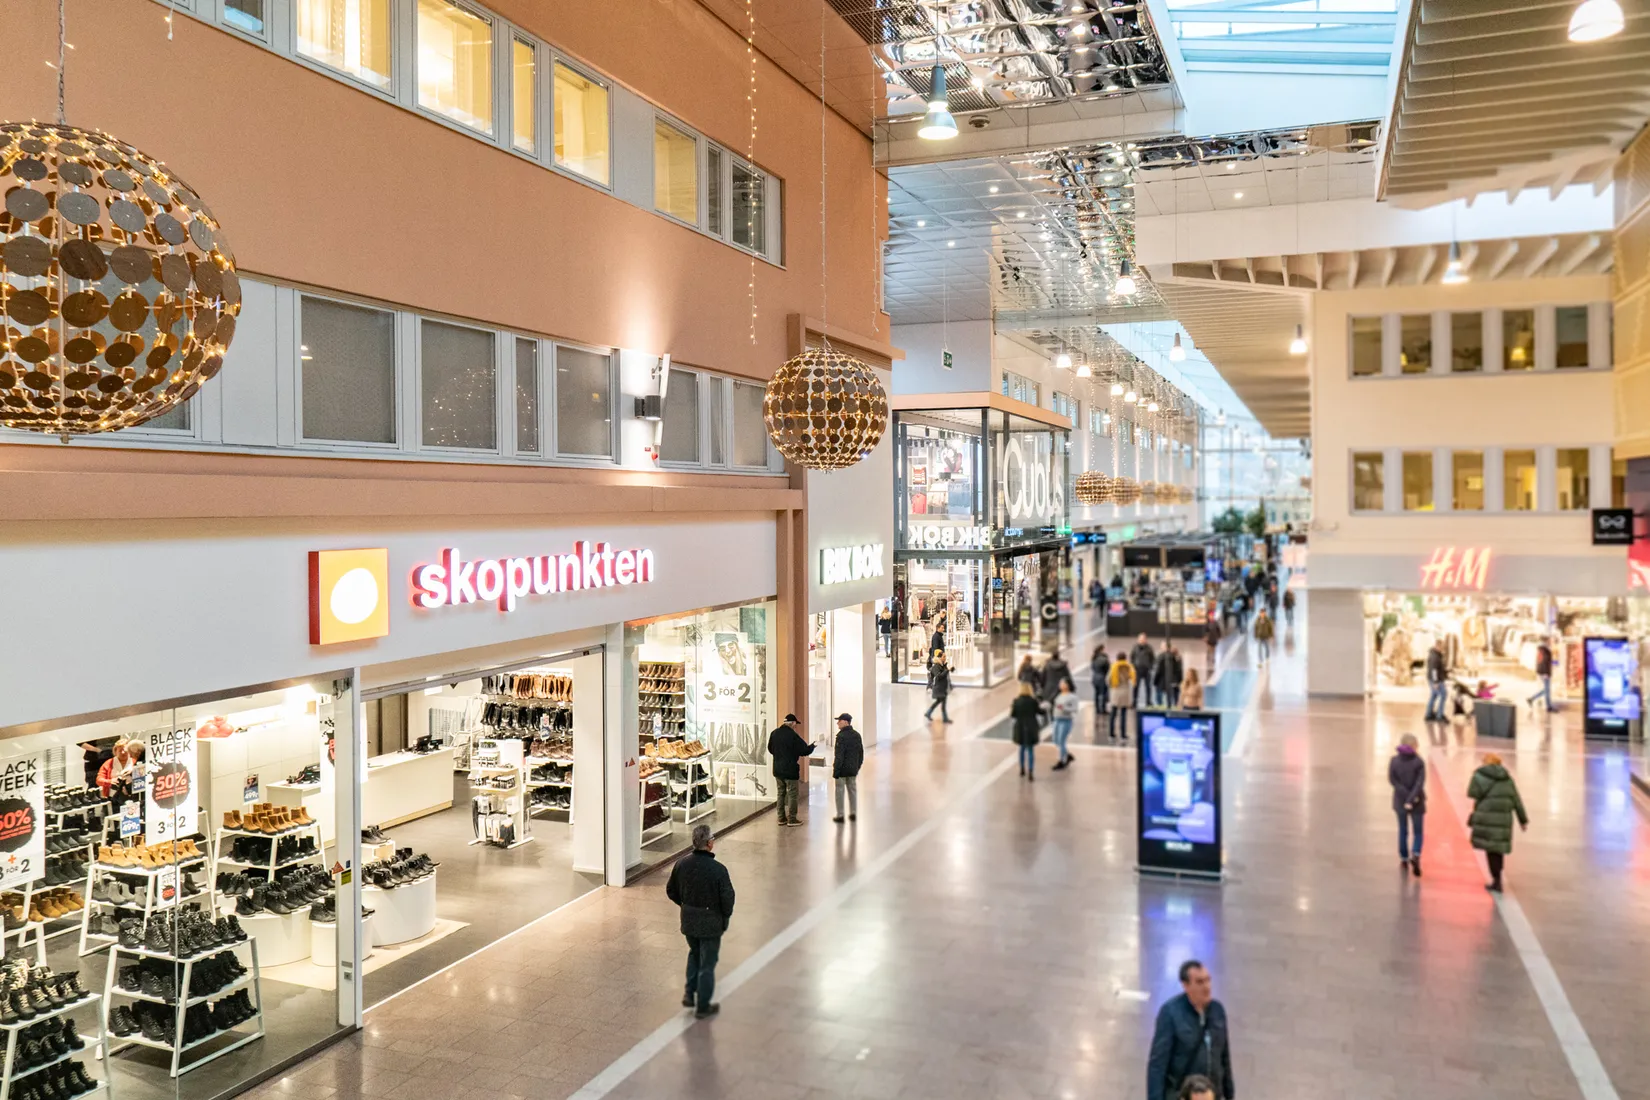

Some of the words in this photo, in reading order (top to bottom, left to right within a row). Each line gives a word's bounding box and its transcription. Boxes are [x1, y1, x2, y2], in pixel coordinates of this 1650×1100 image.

[820, 546, 852, 584] BIK
[852, 544, 884, 581] BOK
[413, 541, 654, 612] skopunkten
[703, 681, 716, 701] 3
[718, 686, 735, 697] FÖR
[738, 682, 751, 703] 2
[151, 728, 192, 746] BLACK
[151, 740, 192, 758] WEEK
[0, 772, 37, 792] EEK
[155, 770, 188, 791] 50%
[158, 821, 166, 834] 3
[179, 816, 186, 828] 2
[21, 858, 30, 874] 2
